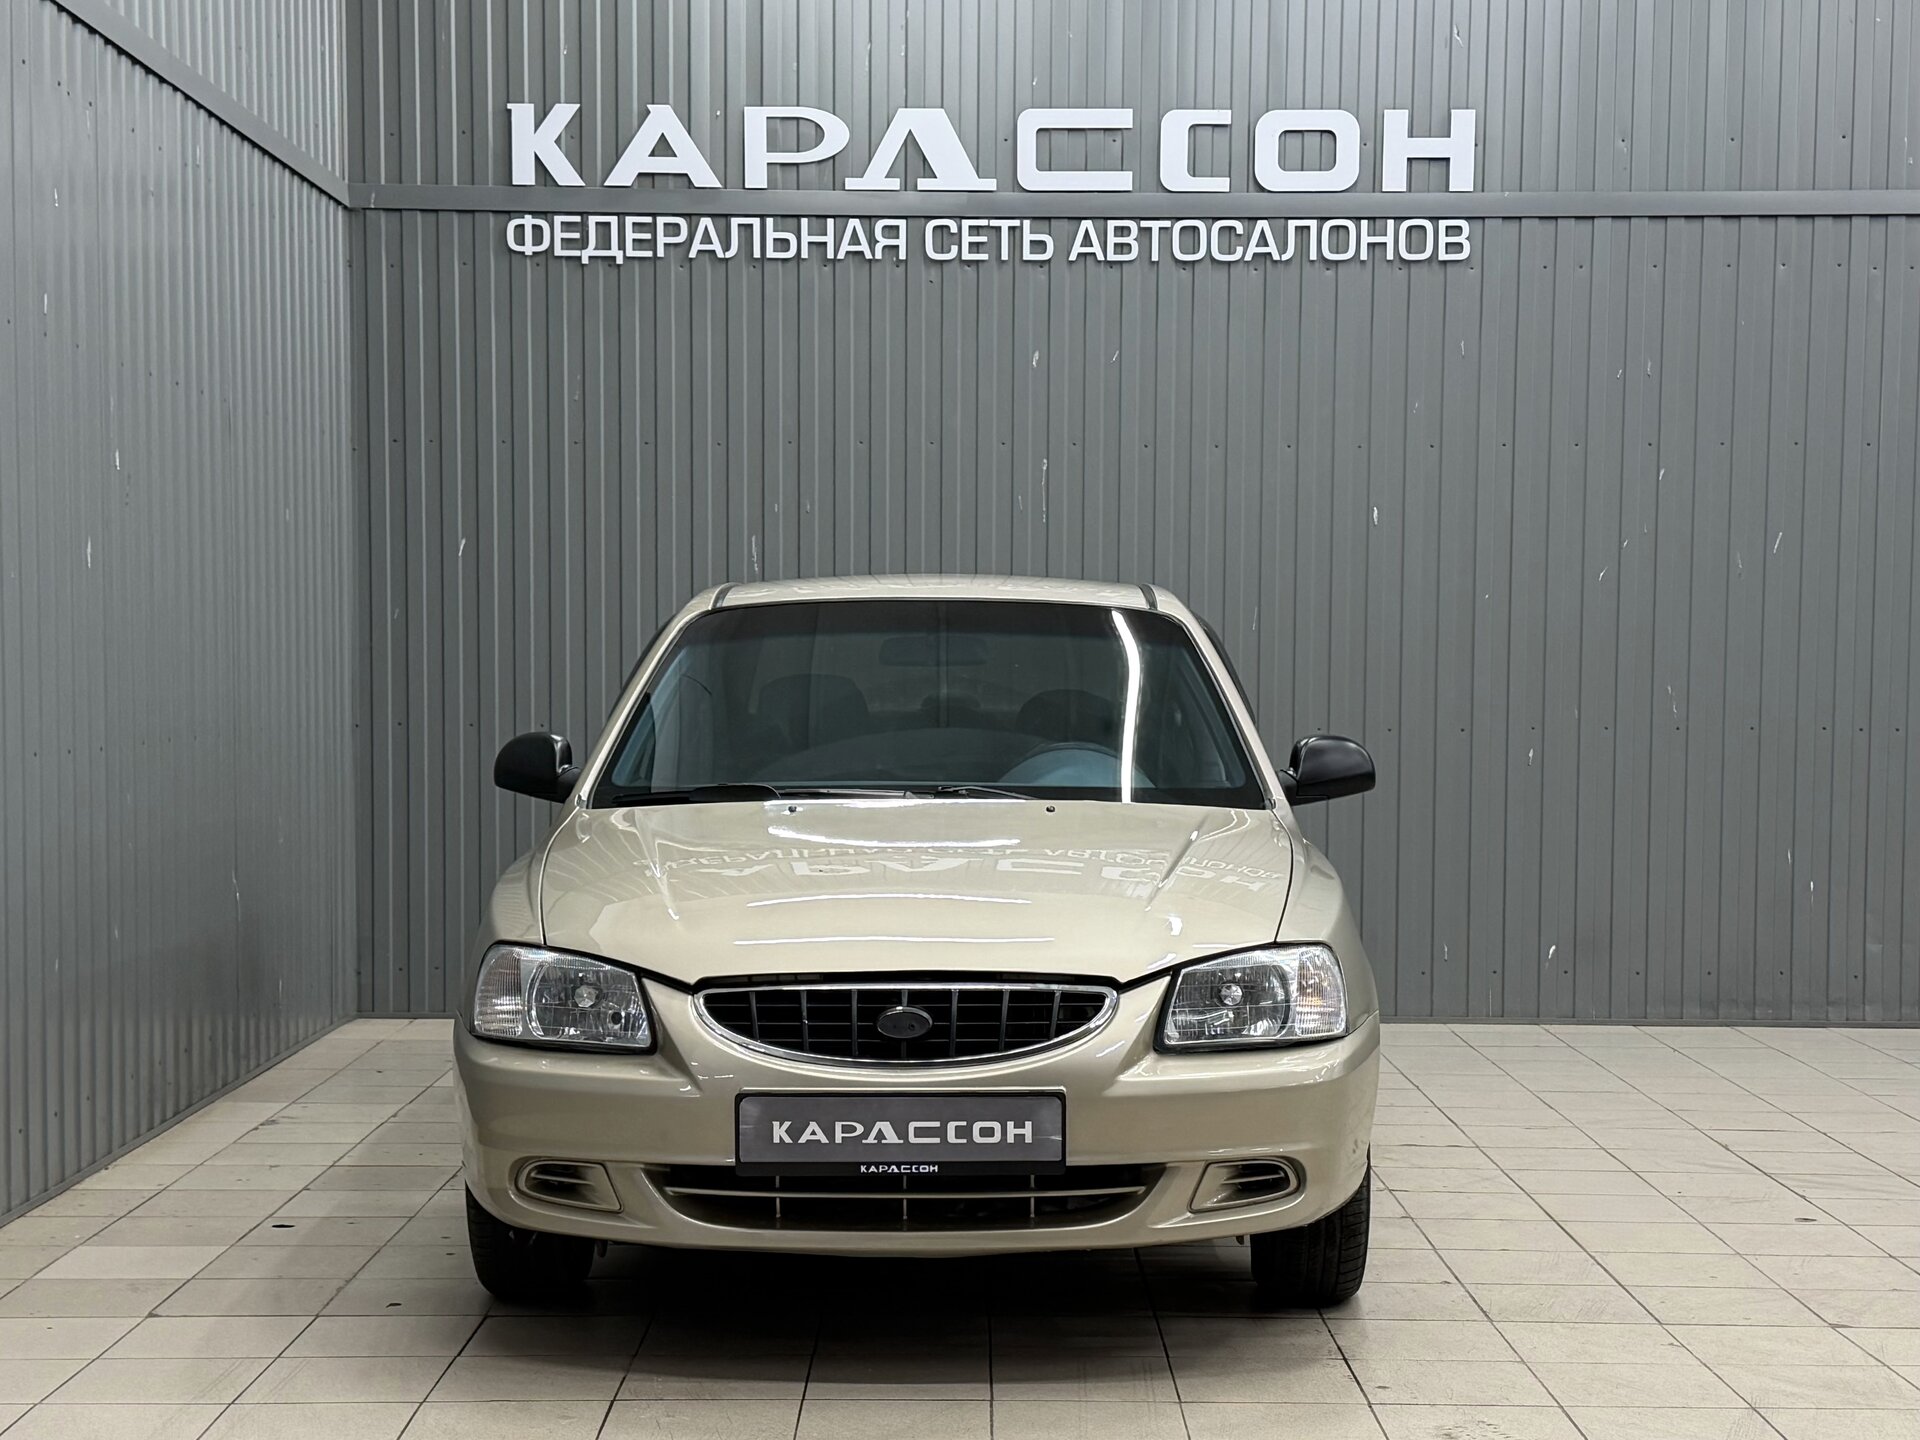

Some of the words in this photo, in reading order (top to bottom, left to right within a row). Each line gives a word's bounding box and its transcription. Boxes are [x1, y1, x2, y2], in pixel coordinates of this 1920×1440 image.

[506, 214, 907, 264] ФЕДЕРАЛЬНАЯ
[925, 218, 1054, 262] СЕТЬ
[1068, 218, 1471, 263] АВТОСАЛОНОВ
